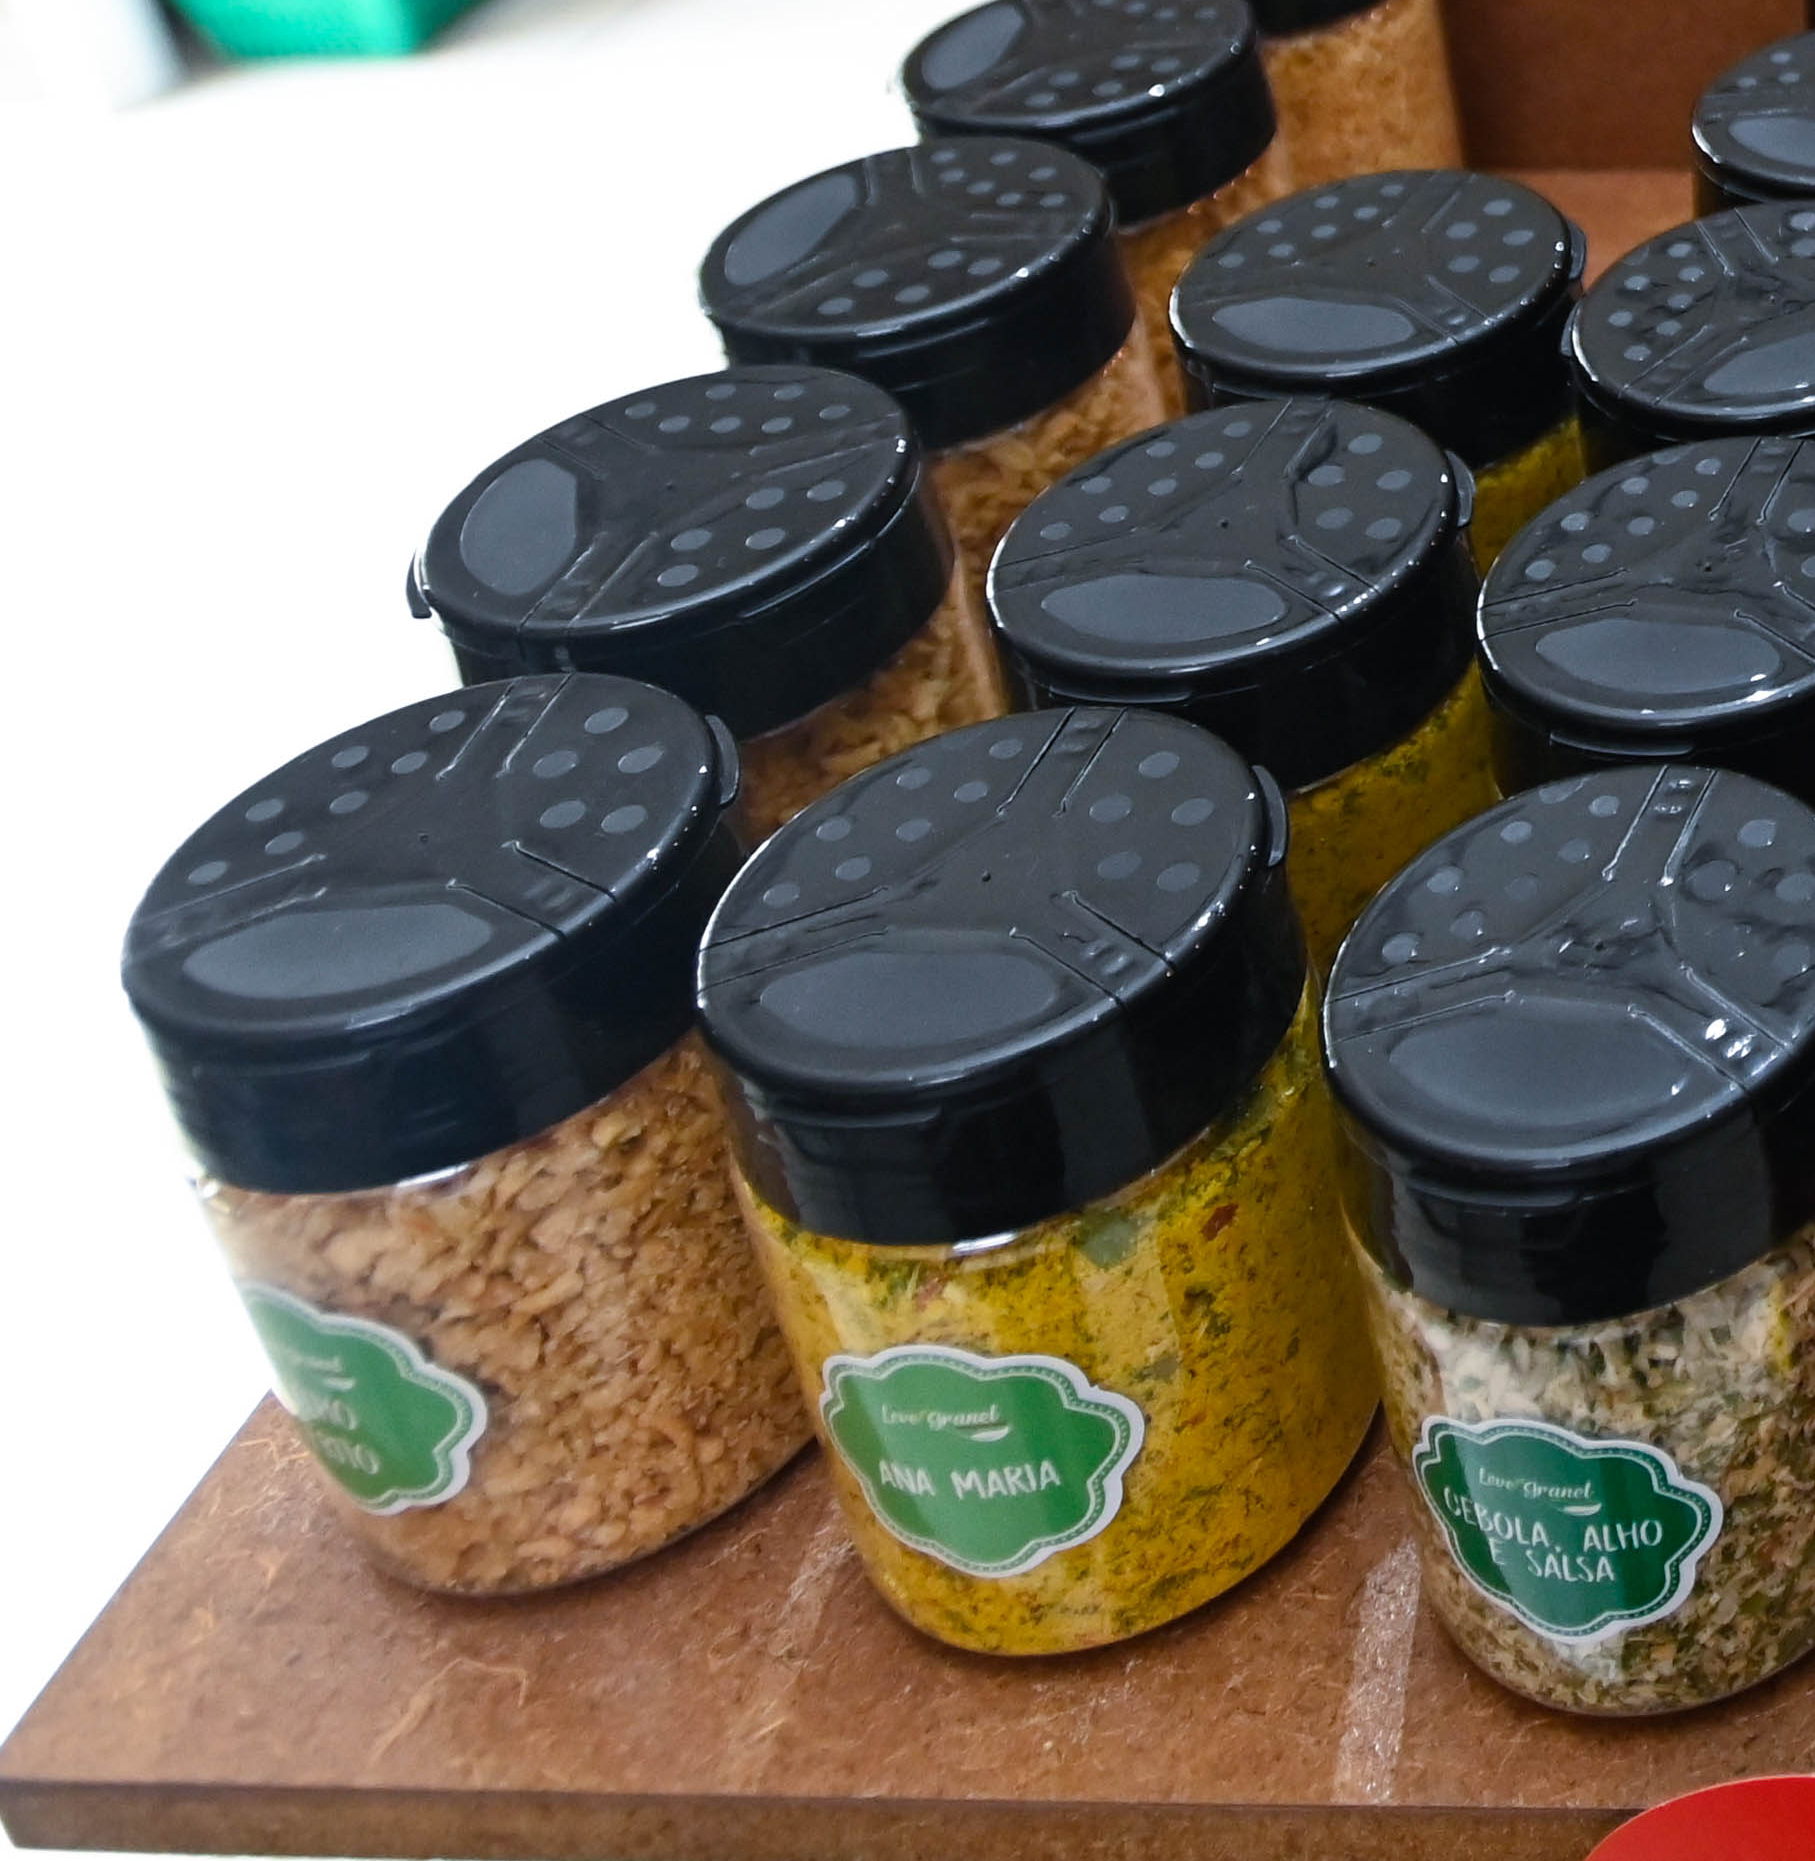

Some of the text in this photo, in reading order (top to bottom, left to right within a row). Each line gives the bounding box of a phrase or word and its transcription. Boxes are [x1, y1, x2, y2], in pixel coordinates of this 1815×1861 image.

[878, 1459, 1062, 1500] ANA MARIA
[1488, 1538, 1616, 1583] E SALSA
[1583, 1519, 1663, 1563] ALHO
